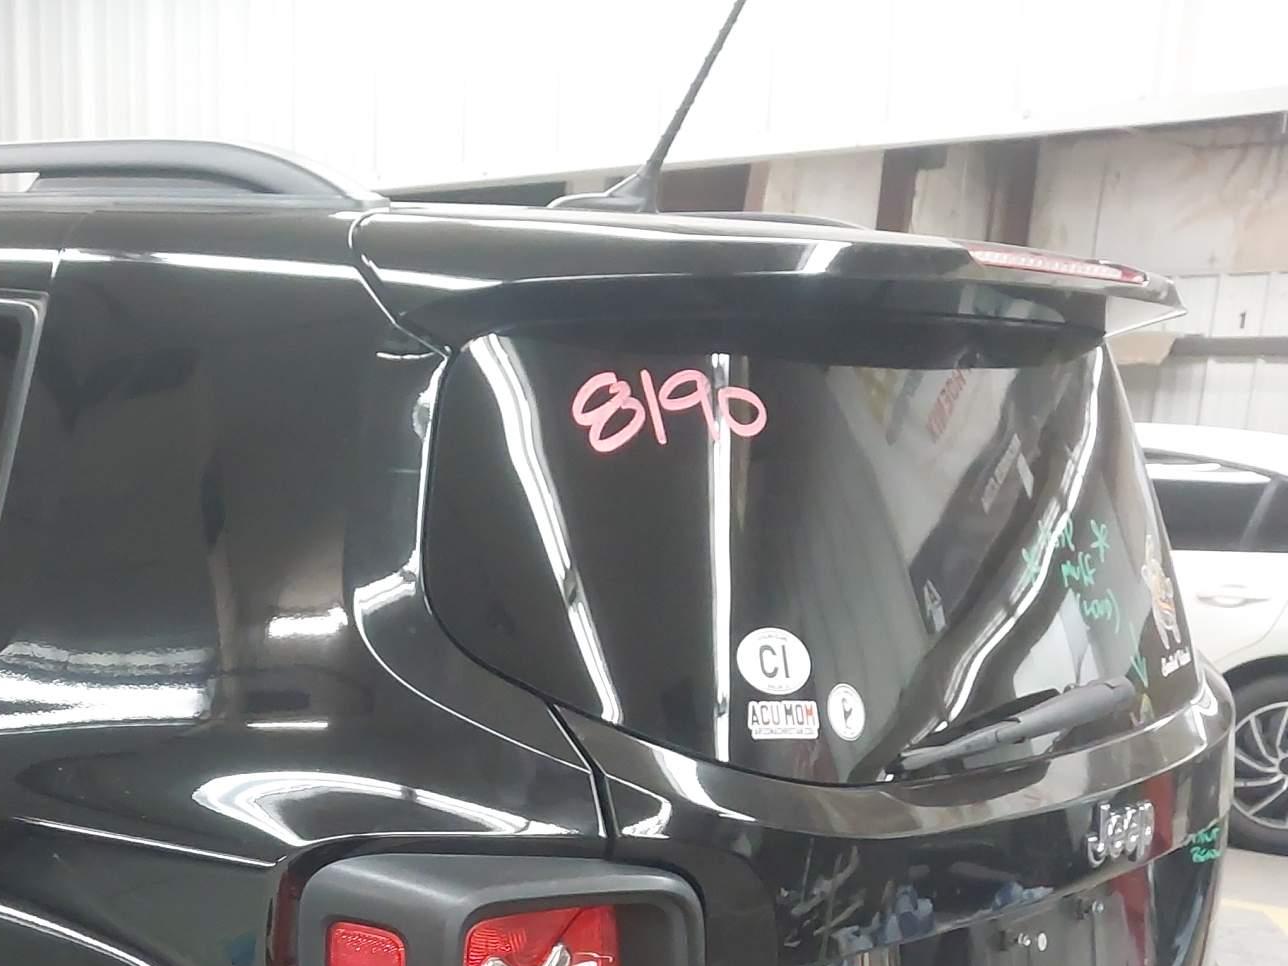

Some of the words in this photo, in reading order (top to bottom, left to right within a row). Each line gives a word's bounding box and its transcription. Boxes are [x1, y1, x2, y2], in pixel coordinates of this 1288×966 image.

[571, 368, 767, 452] 8190
[758, 644, 790, 679] CI
[750, 704, 781, 726] ACU
[783, 704, 816, 727] MOM
[1087, 801, 1154, 868] Jeep
